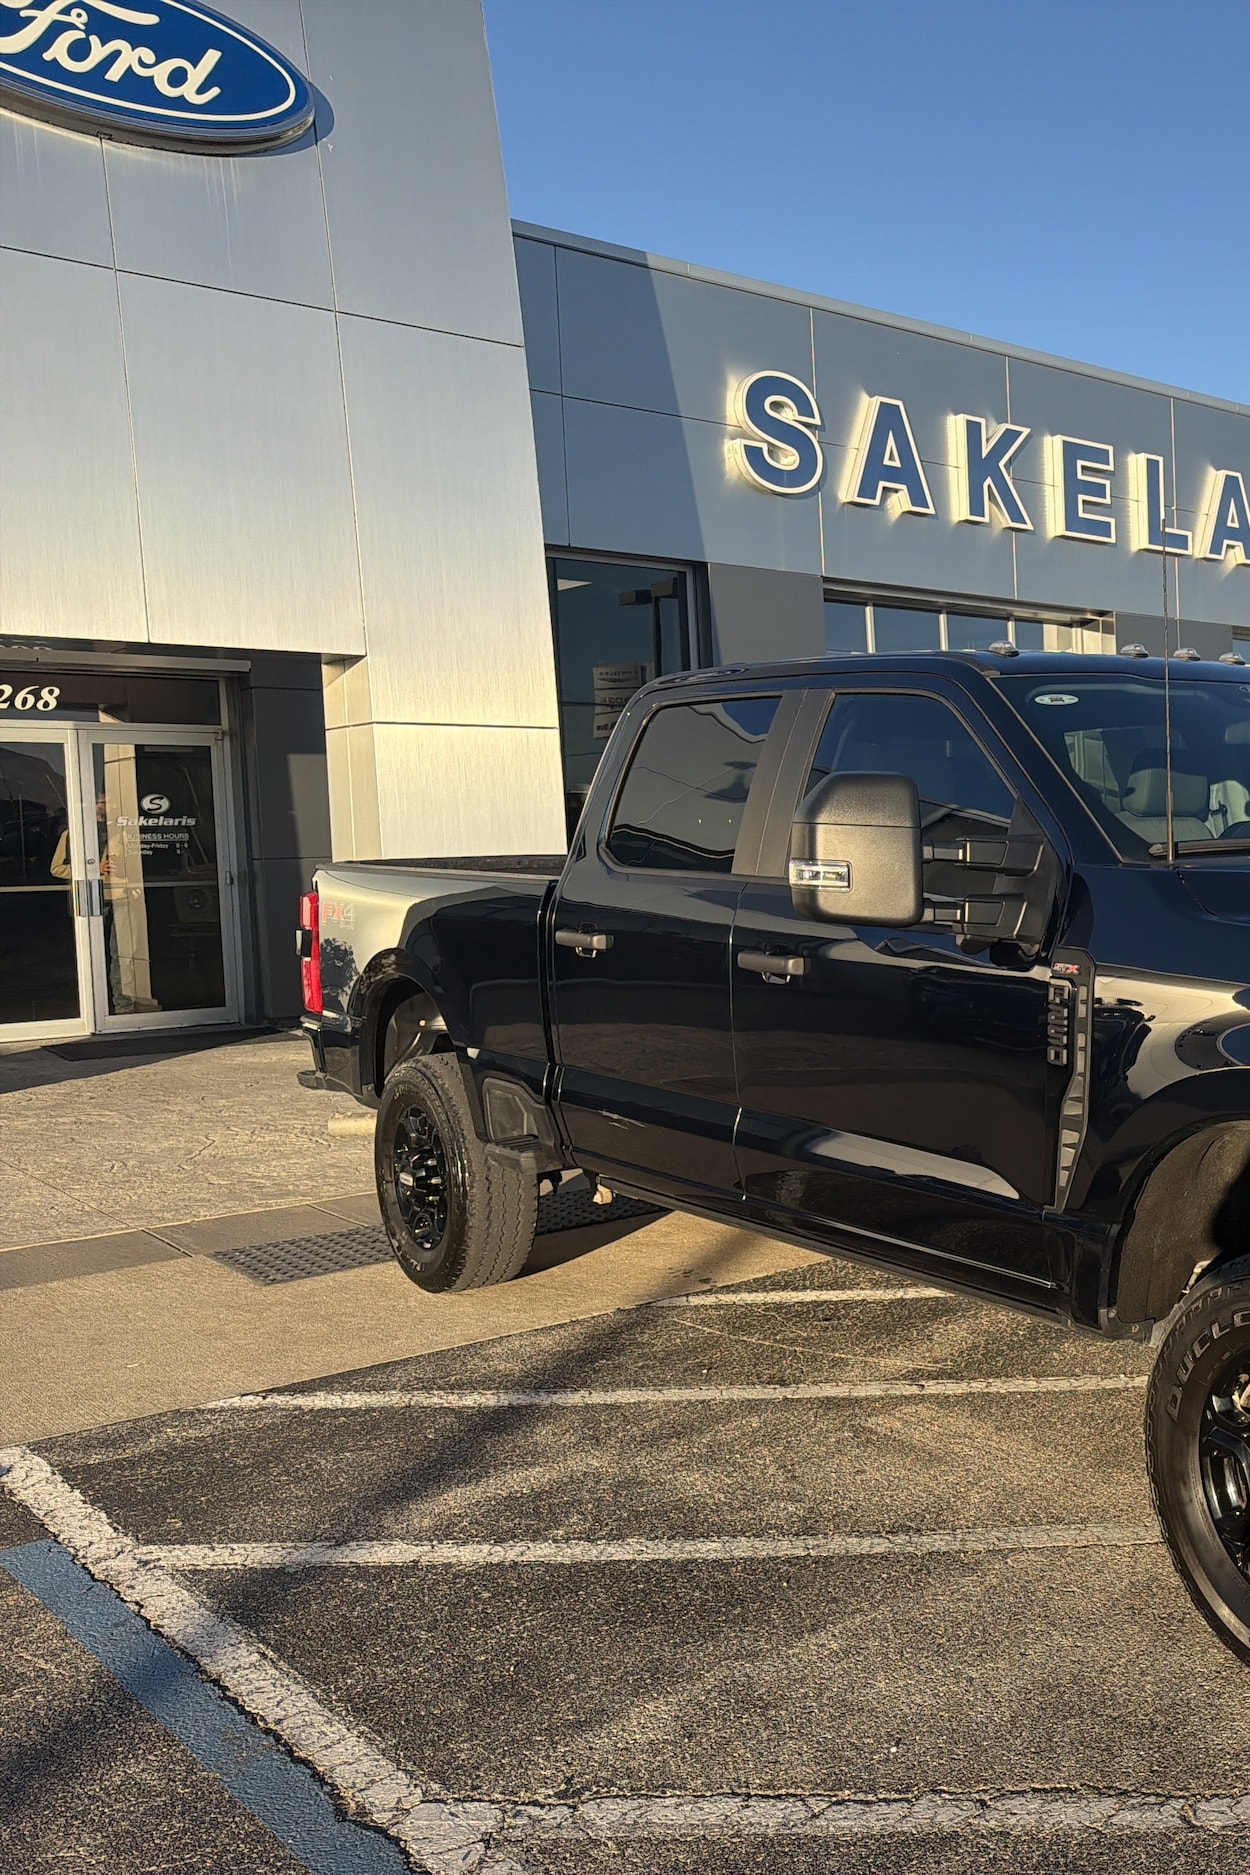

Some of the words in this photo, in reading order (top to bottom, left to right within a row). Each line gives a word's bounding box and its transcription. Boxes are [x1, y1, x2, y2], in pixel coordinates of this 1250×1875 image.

[0, 0, 222, 104] Ford
[0, 684, 60, 711] 268
[116, 815, 196, 827] Sakelaris
[321, 901, 355, 924] FX4
